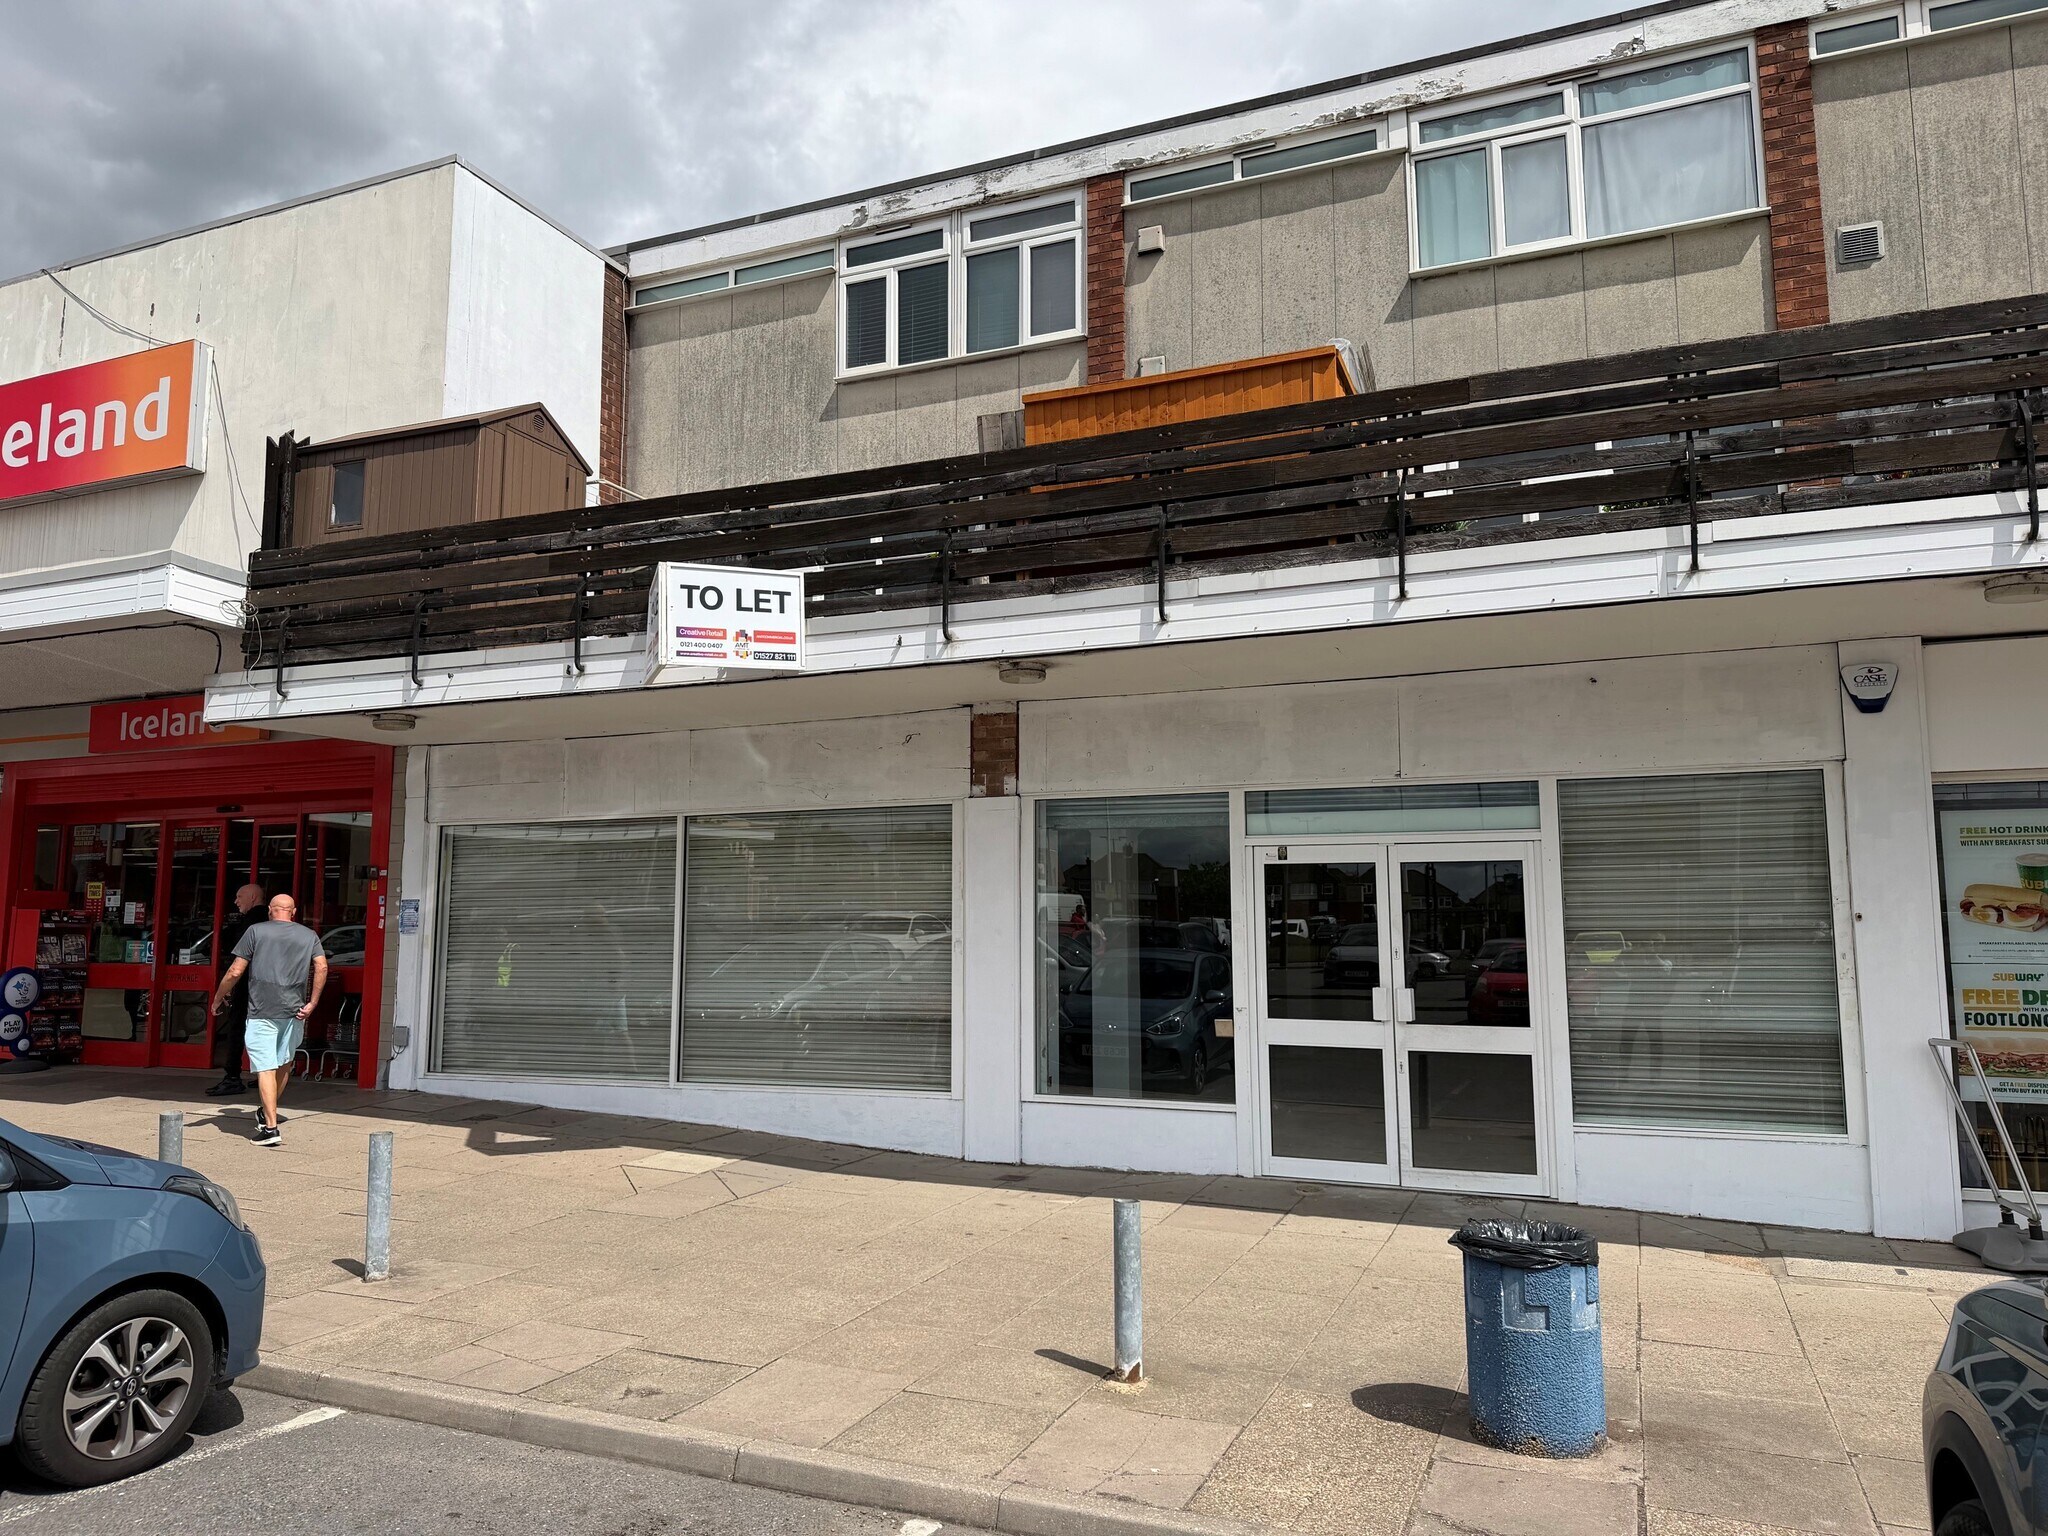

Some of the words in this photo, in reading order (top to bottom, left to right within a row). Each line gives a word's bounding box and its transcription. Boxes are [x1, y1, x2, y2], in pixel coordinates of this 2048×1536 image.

[1, 376, 171, 468] eland
[680, 584, 724, 610] TO
[736, 588, 791, 614] LET
[680, 628, 706, 637] Creative
[1853, 673, 1887, 683] CASE
[1989, 826, 2013, 834] HOT
[1992, 973, 2044, 981] SUBWAY
[1962, 989, 2020, 1005] FREE
